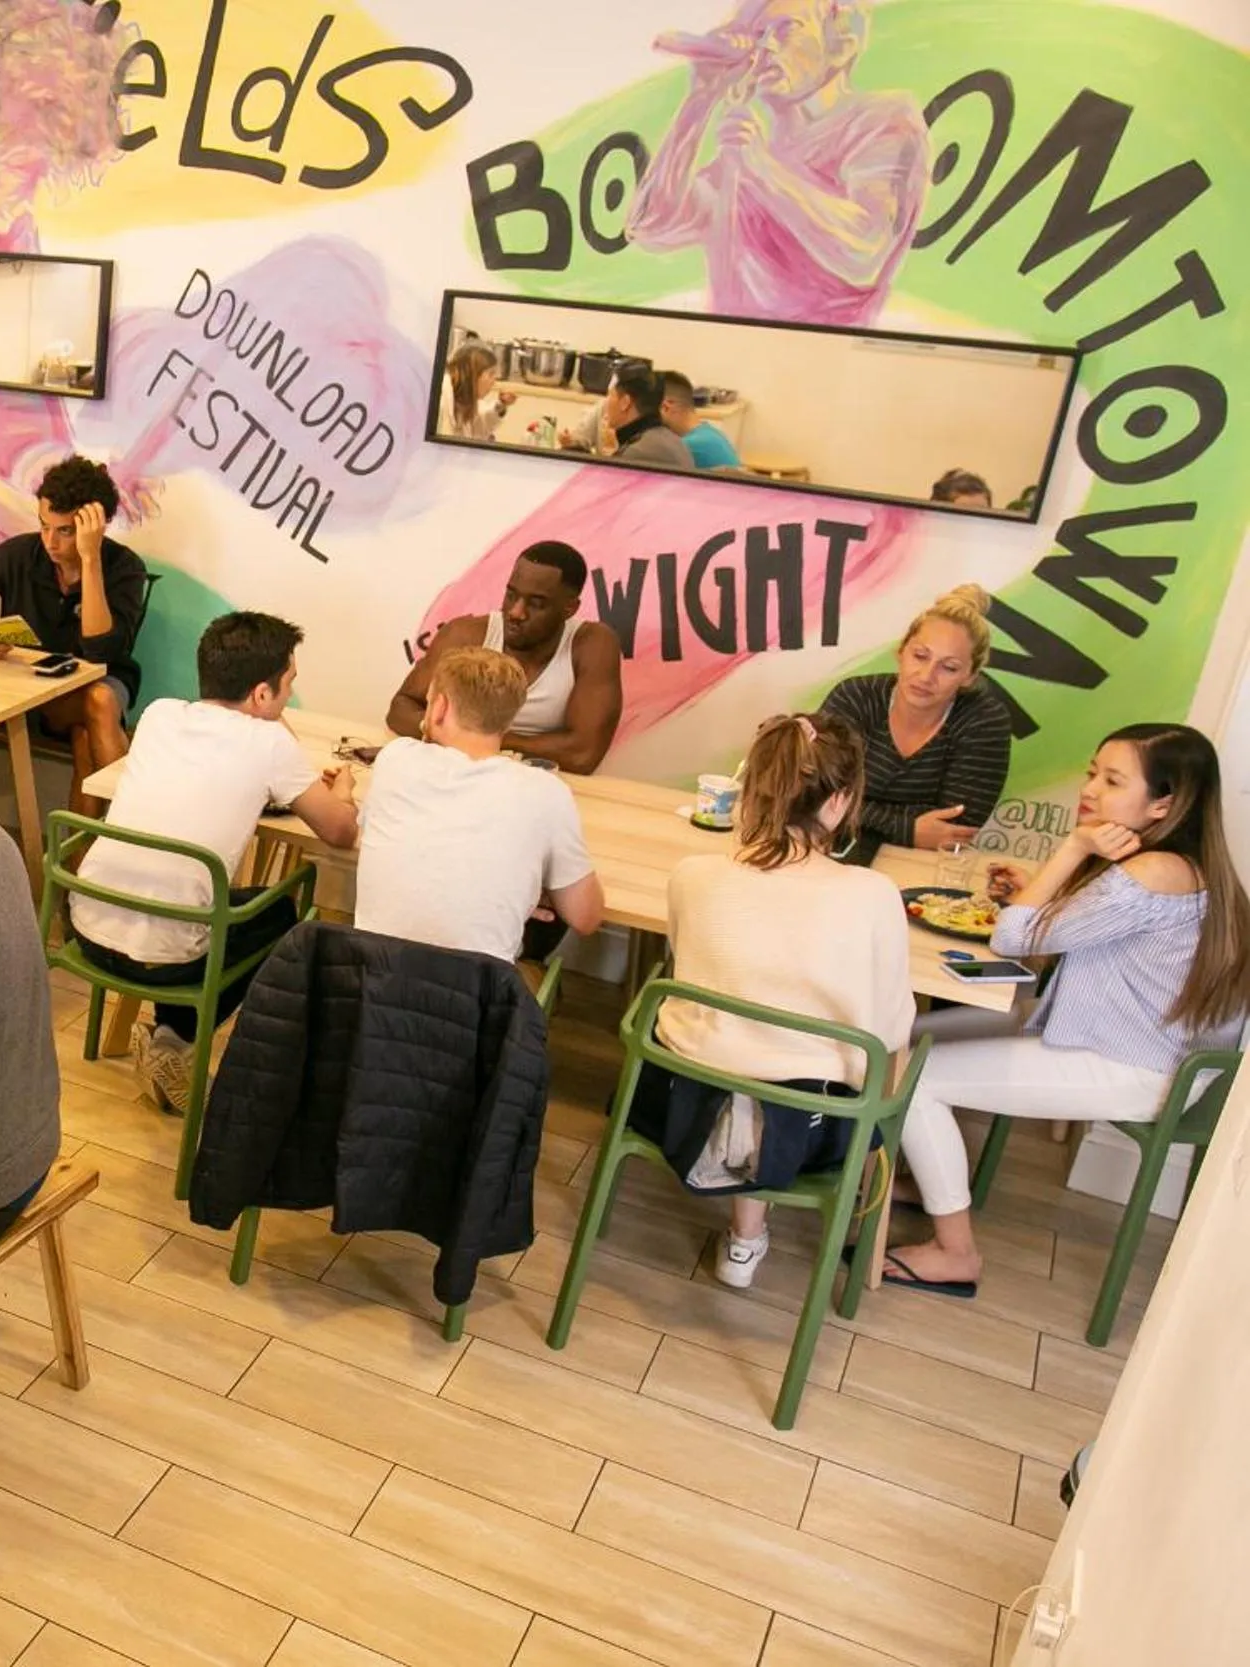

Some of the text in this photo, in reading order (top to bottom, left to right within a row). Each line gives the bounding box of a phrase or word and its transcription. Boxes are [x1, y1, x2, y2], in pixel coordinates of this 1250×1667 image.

[148, 349, 335, 565] FESTIVAL
[175, 268, 395, 477] DOWNLOAD
[591, 519, 869, 662] WIGHT
